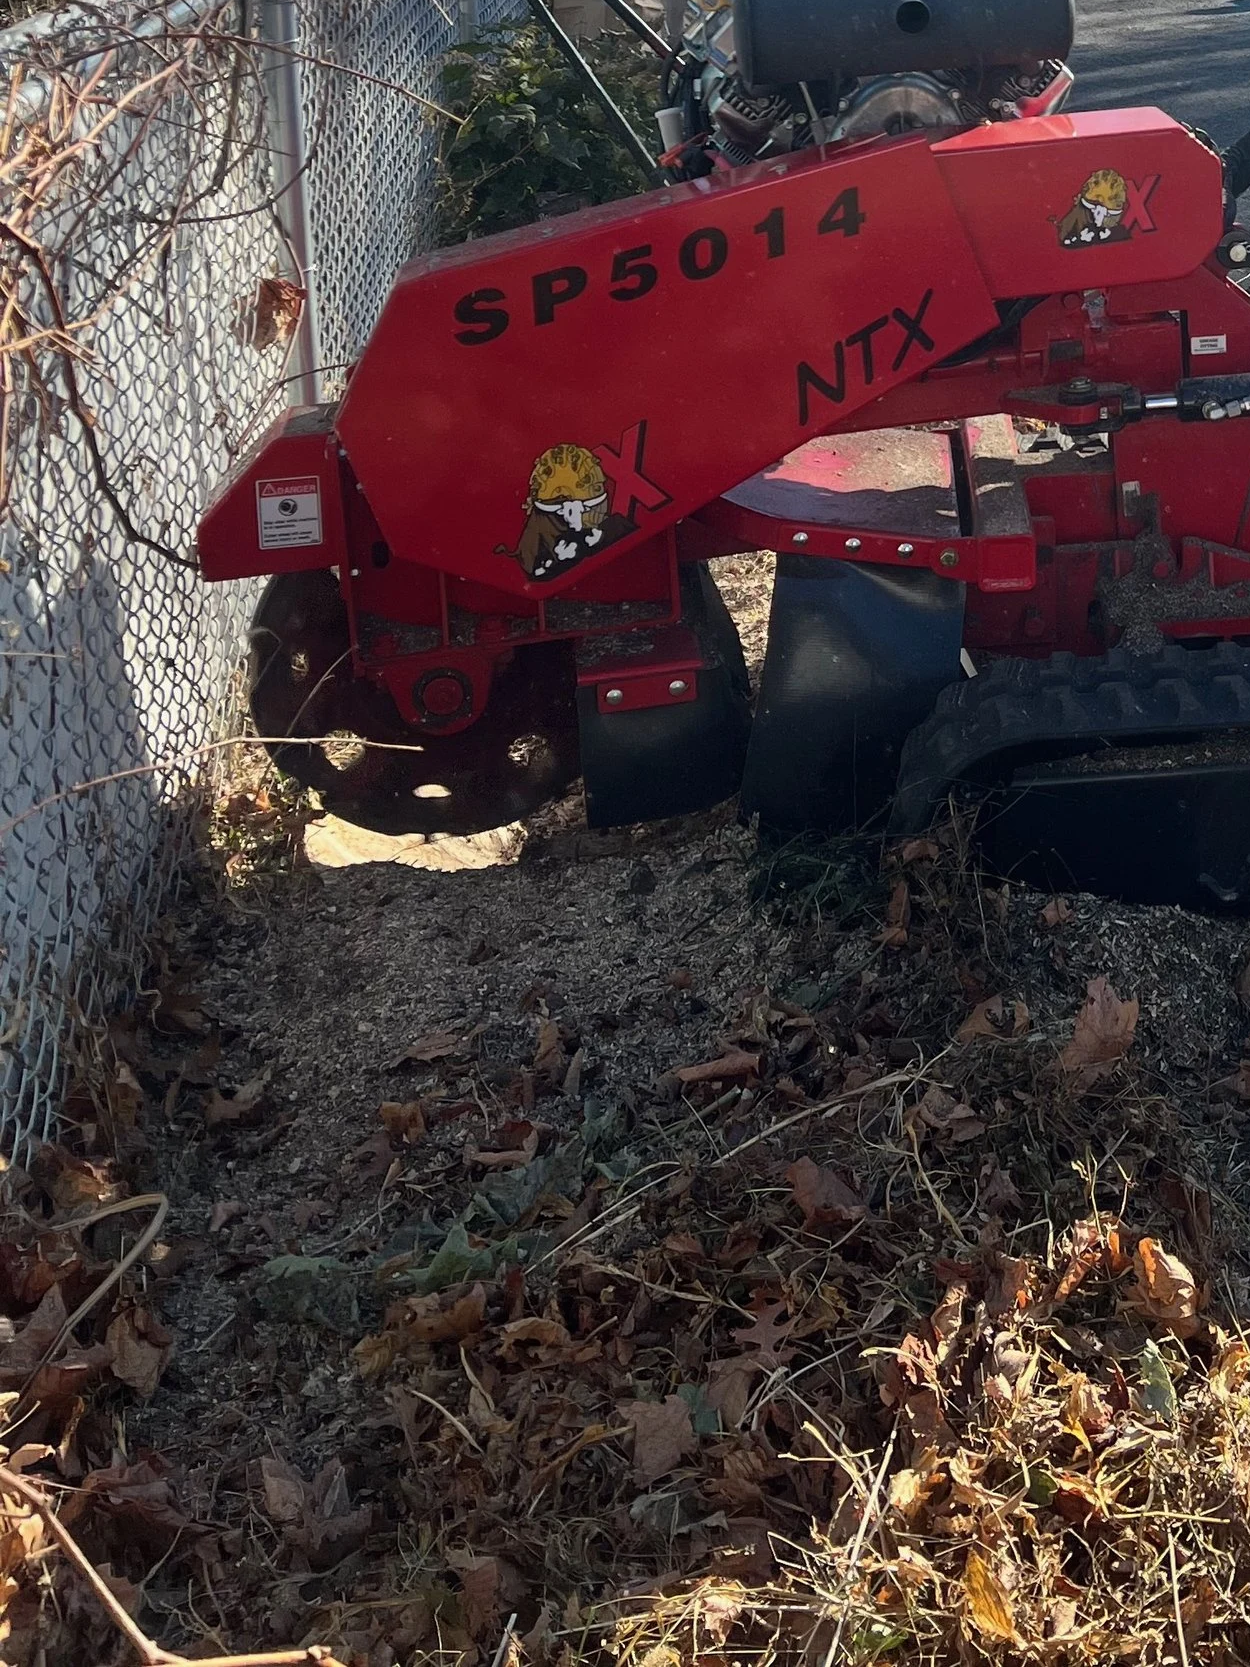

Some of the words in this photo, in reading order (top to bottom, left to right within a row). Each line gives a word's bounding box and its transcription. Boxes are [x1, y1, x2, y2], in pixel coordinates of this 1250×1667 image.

[453, 187, 867, 346] SP5014
[796, 288, 935, 426] NTX
[276, 484, 316, 495] DANGER
